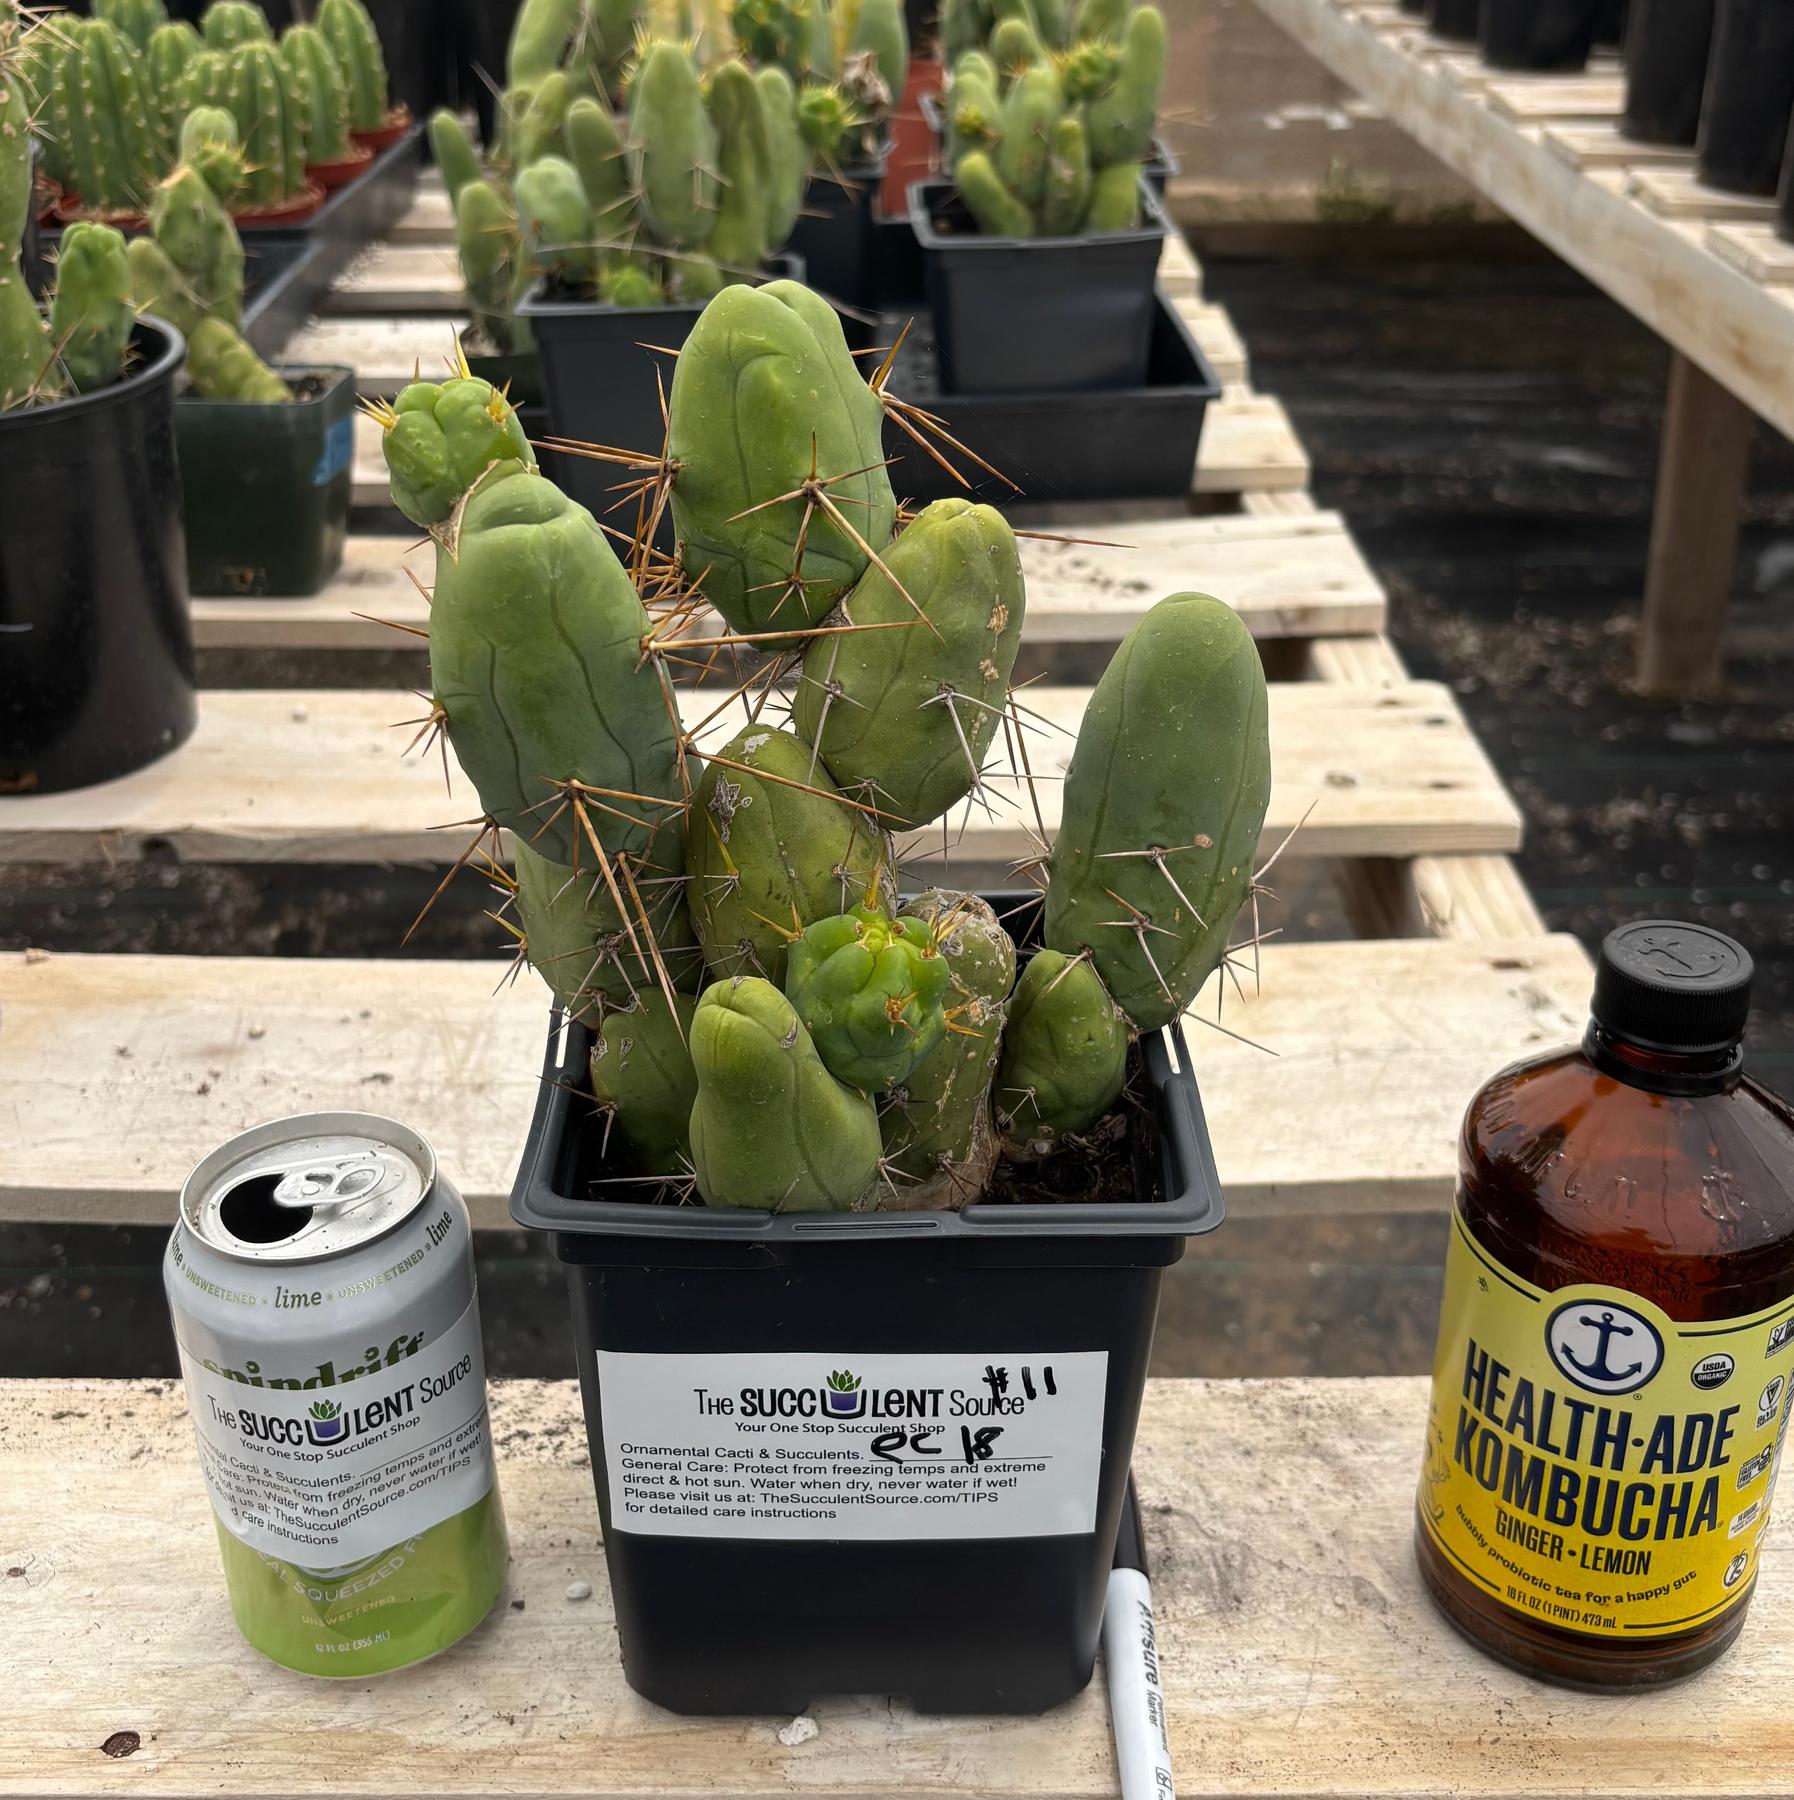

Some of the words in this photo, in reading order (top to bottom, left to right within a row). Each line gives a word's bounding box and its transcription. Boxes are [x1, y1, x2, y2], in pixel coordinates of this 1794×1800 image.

[185, 1266, 257, 1306] UNSWEETENED
[274, 1286, 322, 1309] lime
[338, 1249, 425, 1299] UNSWEETENED
[425, 1210, 453, 1247] lime
[419, 1353, 472, 1404] Source
[1697, 1371, 1727, 1381] ORGANIC
[1702, 1361, 1726, 1372] USDA
[949, 1389, 1025, 1416] Source
[239, 1437, 264, 1453] Your
[266, 1446, 291, 1460] One
[293, 1451, 323, 1463] Stop
[326, 1430, 388, 1459] Succulent
[390, 1416, 421, 1436] Shop
[735, 1422, 766, 1433] Your
[770, 1422, 799, 1433] One
[802, 1422, 835, 1435] Stop
[838, 1423, 907, 1433] Succulent
[909, 1423, 945, 1435] Shop
[293, 1487, 323, 1503] from
[327, 1472, 381, 1502] freezing
[385, 1452, 425, 1475] temps
[429, 1437, 452, 1456] and
[620, 1443, 710, 1458] Ornamental
[714, 1447, 754, 1459] Cacti
[759, 1448, 770, 1459] &
[775, 1449, 864, 1460] Succulents.
[621, 1458, 682, 1472] General
[687, 1461, 729, 1473] Care:
[733, 1463, 788, 1474] Protect
[792, 1463, 827, 1475] from
[832, 1463, 893, 1477] freezing
[898, 1463, 945, 1476] temps
[950, 1463, 979, 1474] and
[983, 1462, 1046, 1473] extreme
[230, 1456, 260, 1474] Cacti
[263, 1468, 273, 1478] &
[276, 1471, 356, 1488] Succulents.
[263, 1490, 299, 1511] Water
[302, 1504, 339, 1518] when
[342, 1495, 366, 1510] dry,
[369, 1473, 406, 1497] never
[409, 1456, 445, 1478] water
[448, 1449, 457, 1460] if
[622, 1473, 664, 1485] direct
[669, 1475, 681, 1486] &
[685, 1476, 709, 1487] hot
[713, 1478, 745, 1488] sun.
[750, 1478, 796, 1489] Water
[800, 1478, 841, 1490] when
[846, 1479, 873, 1493] dry,
[878, 1480, 922, 1490] never
[925, 1478, 969, 1489] water
[973, 1477, 982, 1488] if
[986, 1477, 1017, 1488] wet!
[1453, 1403, 1720, 1542] KOMBUCHA
[274, 1456, 471, 1532] TheSucculentSource.com/TIPS
[624, 1488, 676, 1500] Please
[679, 1490, 710, 1501] visit
[714, 1493, 732, 1502] us
[736, 1492, 755, 1503] at:
[760, 1492, 999, 1504] TheSucculentSource.com/TIPS
[625, 1502, 646, 1513] for
[649, 1504, 708, 1516] detailed
[713, 1508, 746, 1517] care
[750, 1507, 837, 1519] instructions
[241, 1510, 265, 1528] care
[267, 1520, 339, 1545] instructions
[1495, 1508, 1563, 1562] GINGER
[1580, 1543, 1652, 1576] LEMON
[1456, 1503, 1488, 1548] bubbly
[1487, 1547, 1552, 1591] probiotic
[1555, 1585, 1581, 1601] tea
[1585, 1591, 1611, 1603] for
[1614, 1594, 1624, 1603] a
[1626, 1584, 1670, 1602] happy
[1673, 1570, 1697, 1590] gut
[293, 1555, 405, 1602] SQUEEZED
[1517, 1590, 1527, 1606] FL
[1528, 1595, 1542, 1611] OZ
[1542, 1600, 1552, 1615] (1
[1553, 1603, 1580, 1623] PINT)
[1581, 1612, 1601, 1627] 473
[1602, 1616, 1617, 1629] mL
[1146, 1689, 1158, 1728] Marker
